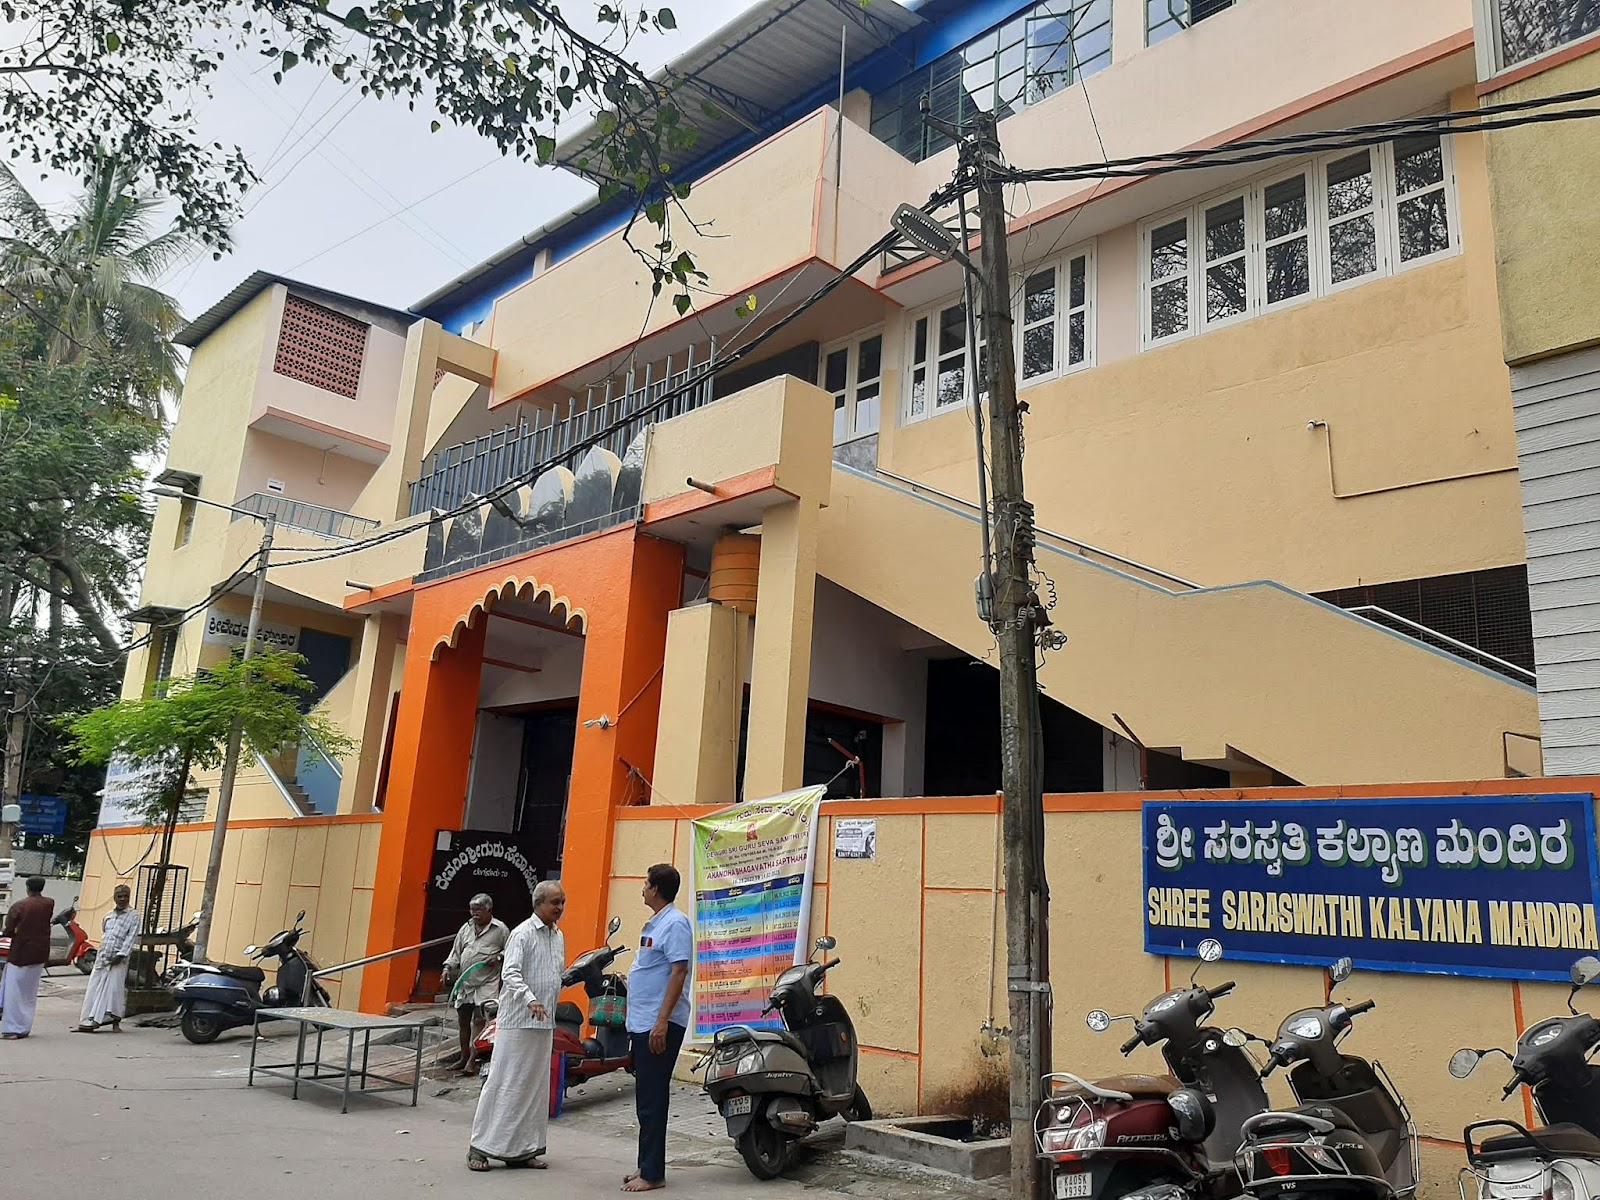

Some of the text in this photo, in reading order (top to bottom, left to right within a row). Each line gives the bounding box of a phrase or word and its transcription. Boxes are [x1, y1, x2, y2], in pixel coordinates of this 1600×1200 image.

[738, 843, 757, 852] GURU
[757, 839, 774, 848] SEVA
[1156, 812, 1570, 885] ಶ್ರೀ ಸರಸ್ವತಿ ಕಲ್ಯಾಣ ಮಂದಿರ
[1148, 886, 1600, 950] SHREE SARASWATHI KALYANA MANDIRA
[1064, 1174, 1087, 1187] KA05K
[1281, 1181, 1296, 1190] TVS
[1064, 1185, 1087, 1197] Y9392
